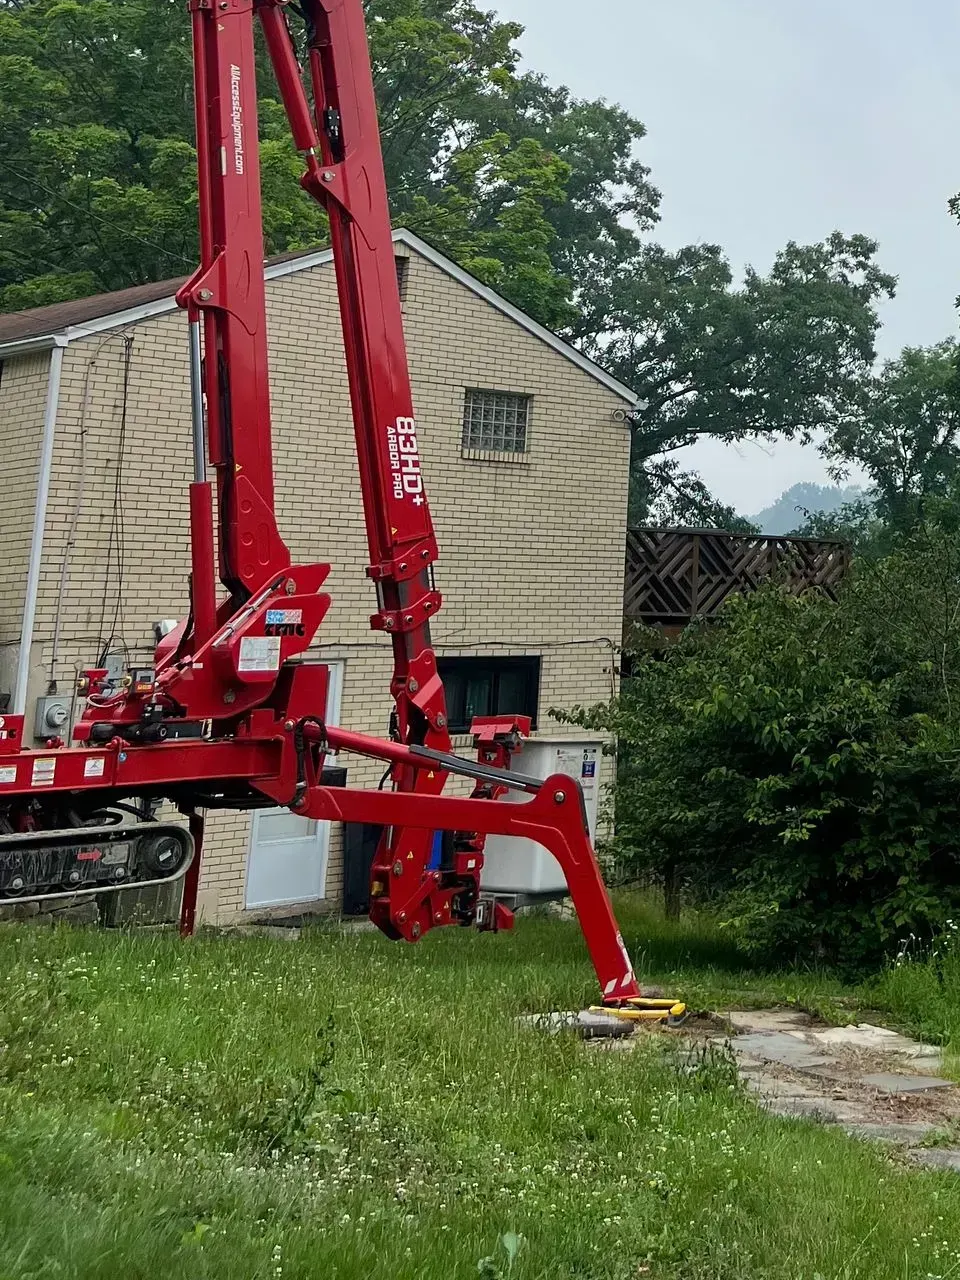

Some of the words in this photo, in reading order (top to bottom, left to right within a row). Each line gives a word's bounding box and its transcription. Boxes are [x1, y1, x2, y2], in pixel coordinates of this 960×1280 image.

[230, 64, 243, 175] AllAccessEquipment.com
[386, 426, 400, 470] ARBOR
[396, 416, 424, 506] 83HD+
[392, 472, 404, 499] PRO
